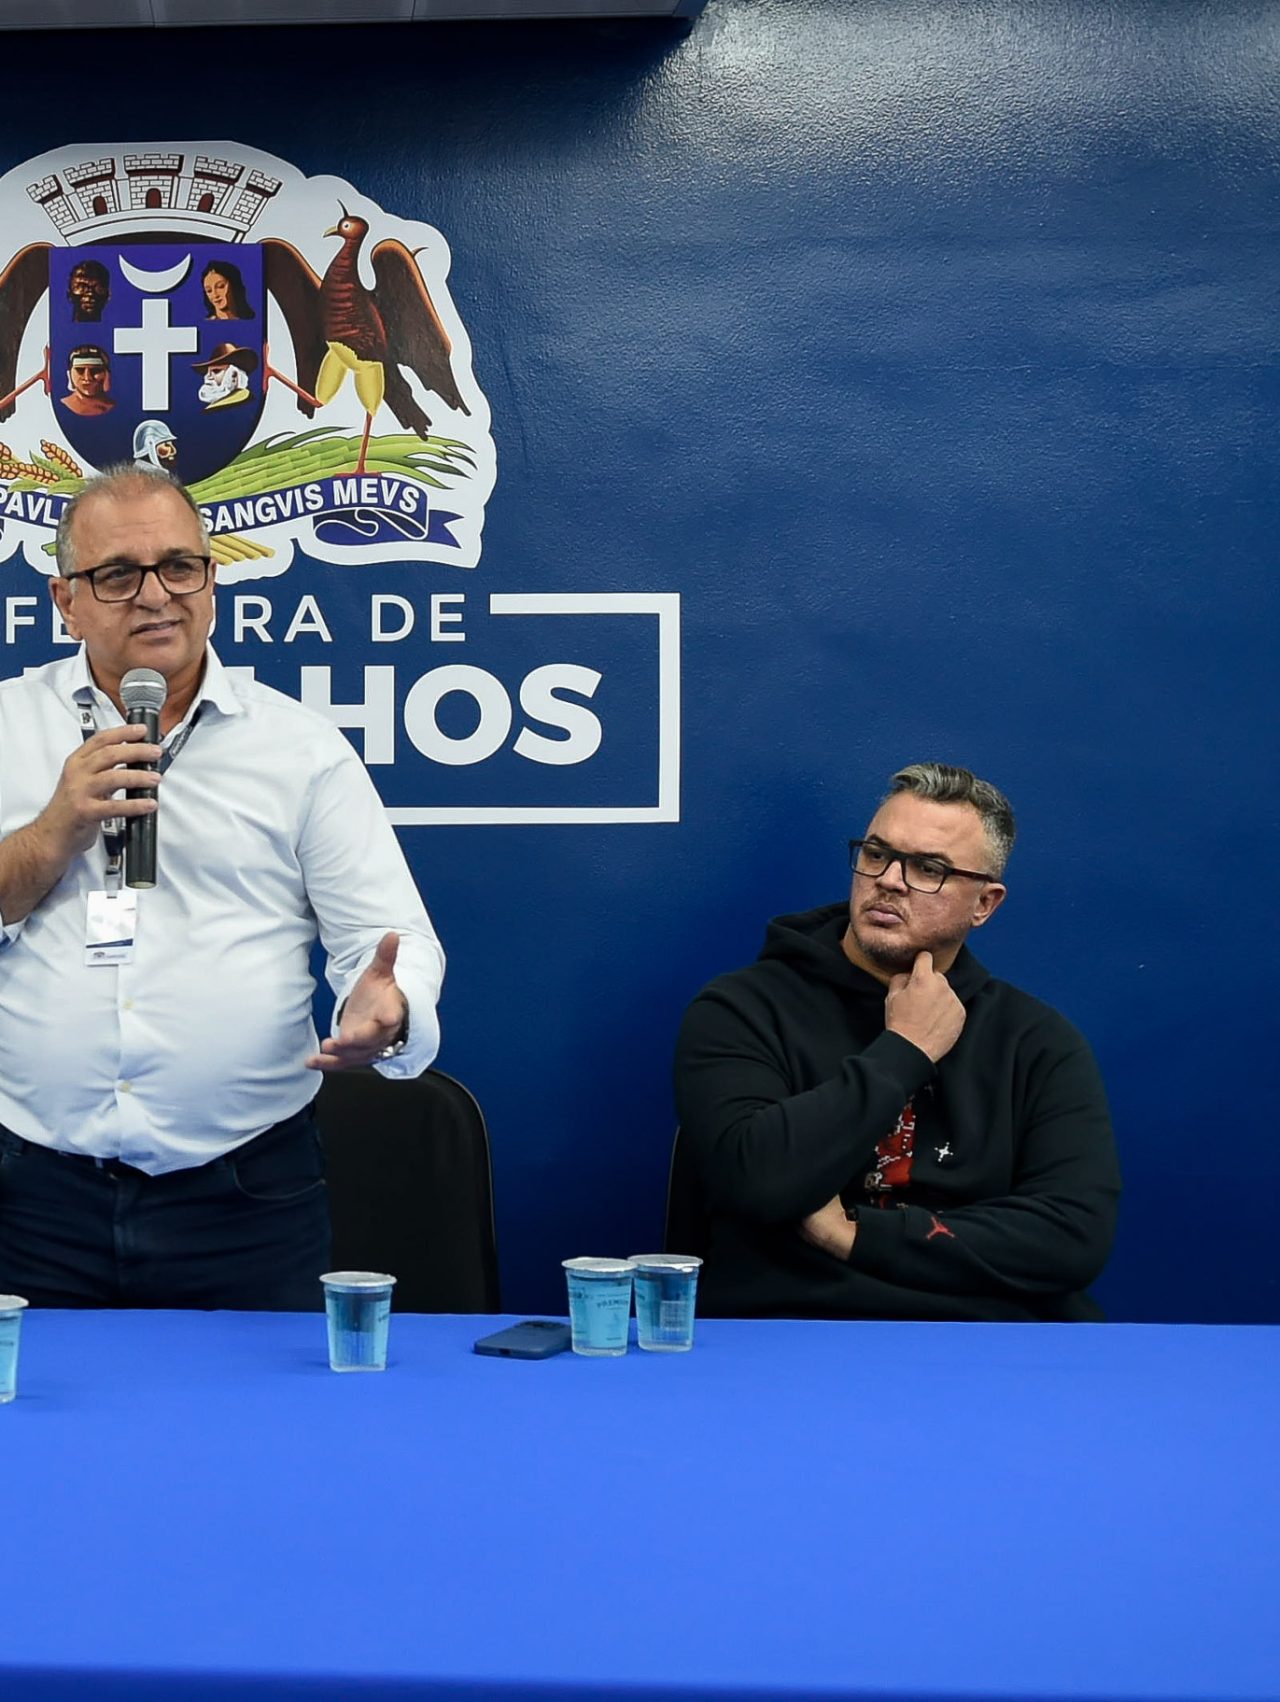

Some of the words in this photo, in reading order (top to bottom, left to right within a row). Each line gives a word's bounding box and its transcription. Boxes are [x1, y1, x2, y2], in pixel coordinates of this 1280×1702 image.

[199, 483, 324, 533] SANGVIS
[332, 478, 420, 514] MEVS
[371, 593, 466, 643] DE
